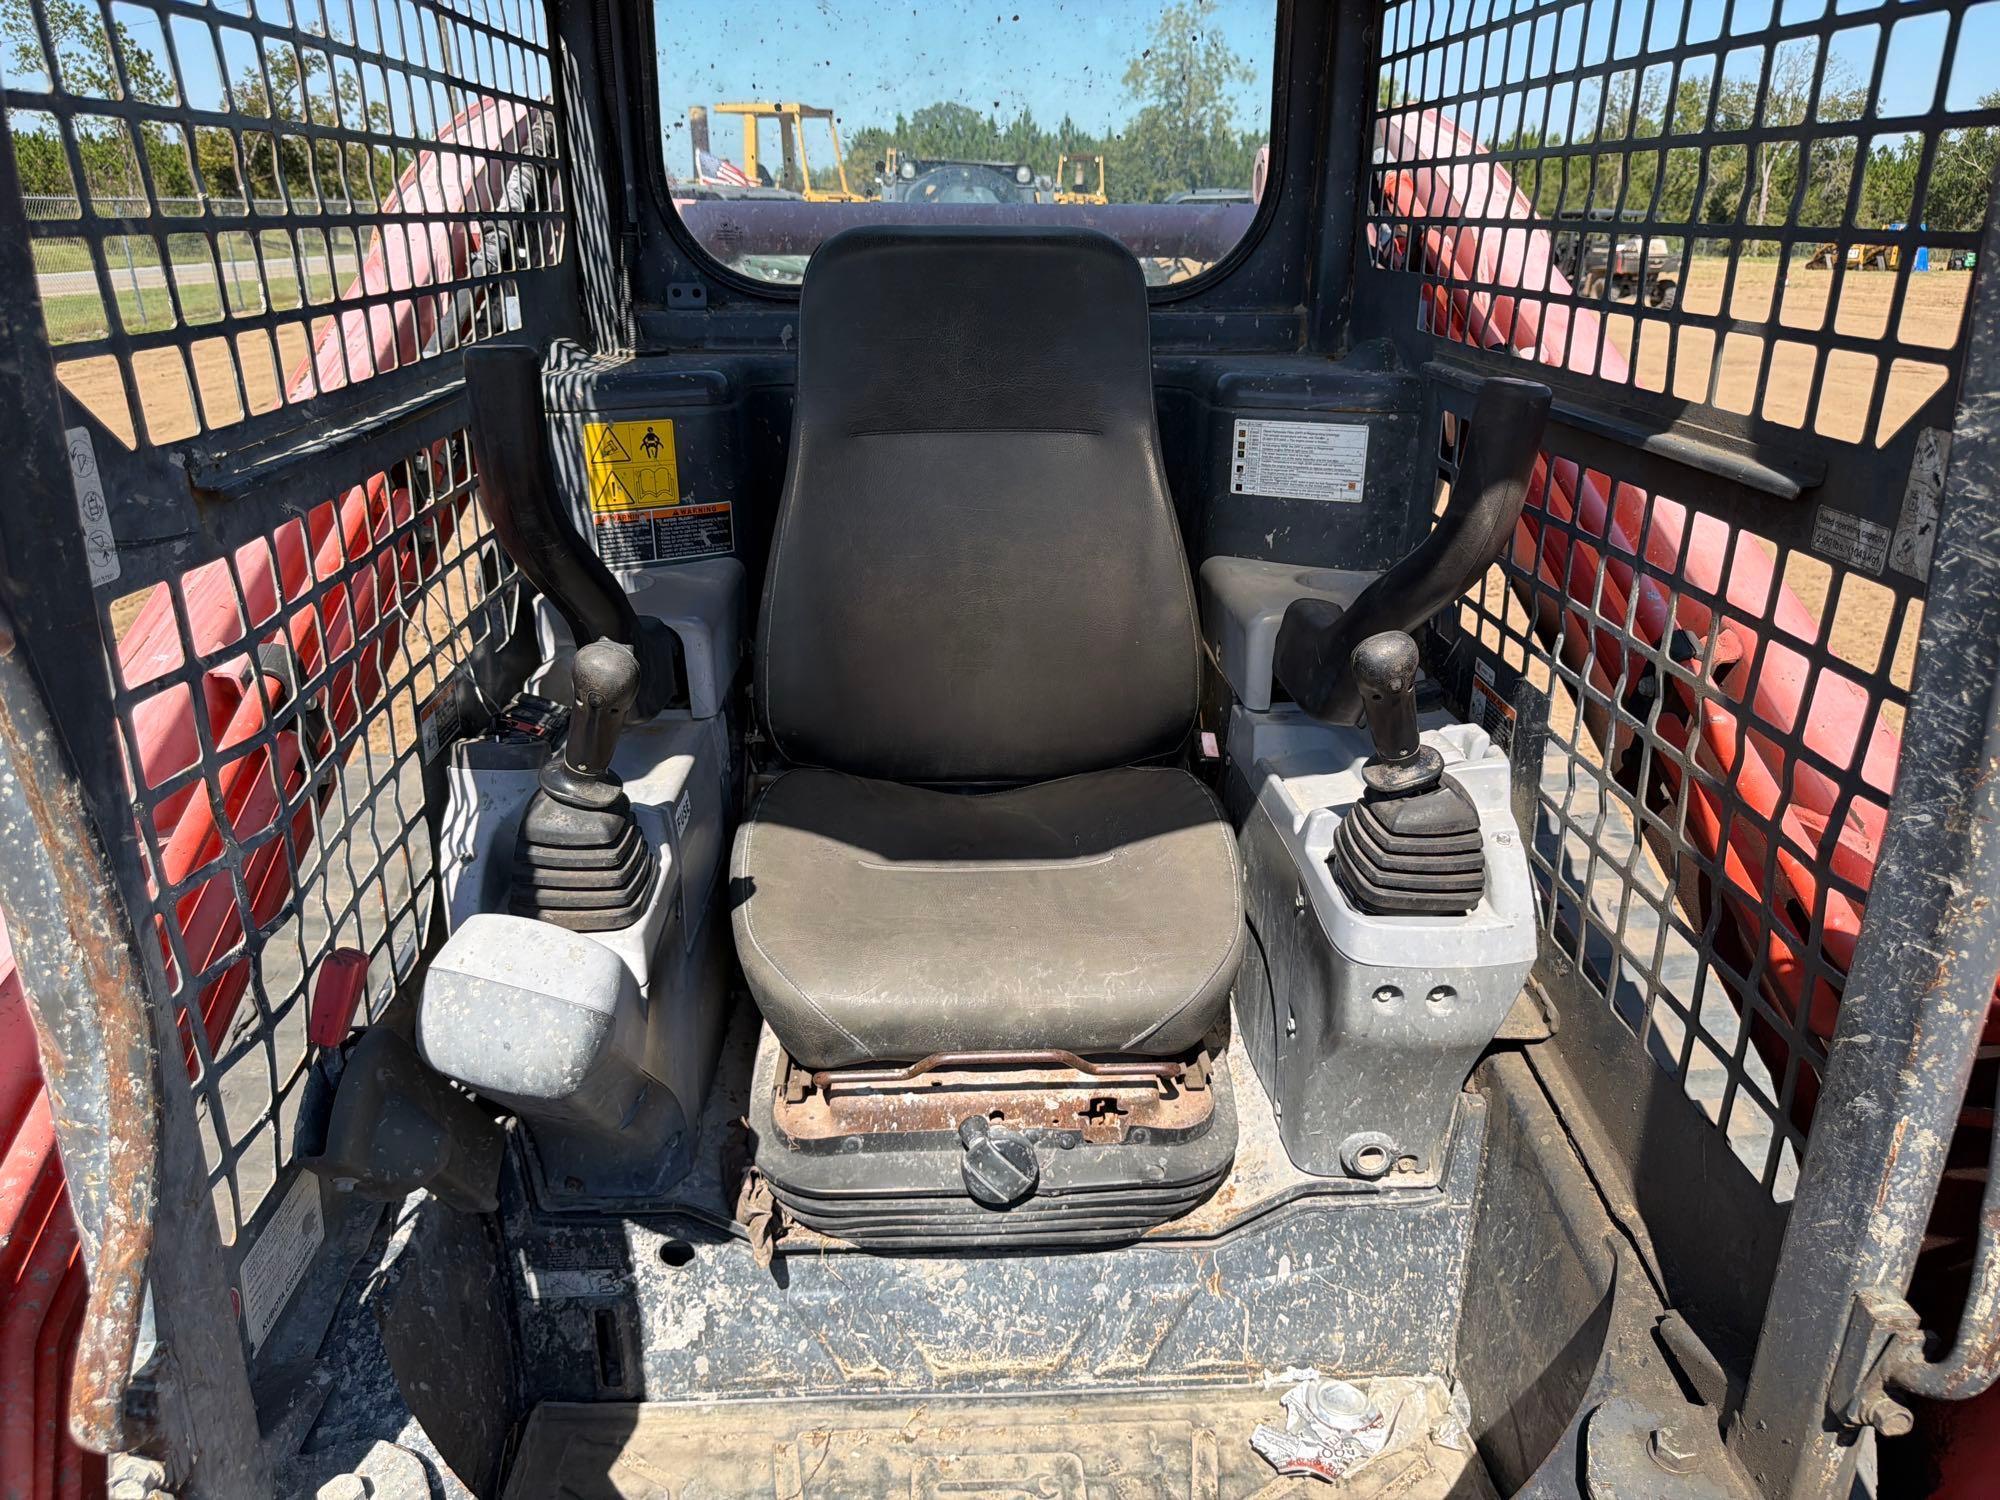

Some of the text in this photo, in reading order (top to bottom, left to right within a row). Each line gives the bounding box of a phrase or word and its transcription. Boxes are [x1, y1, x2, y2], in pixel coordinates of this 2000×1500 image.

[681, 506, 717, 515] WARNING
[676, 799, 691, 831] FUSE
[263, 1241, 315, 1332] KUBOTA Corporation
